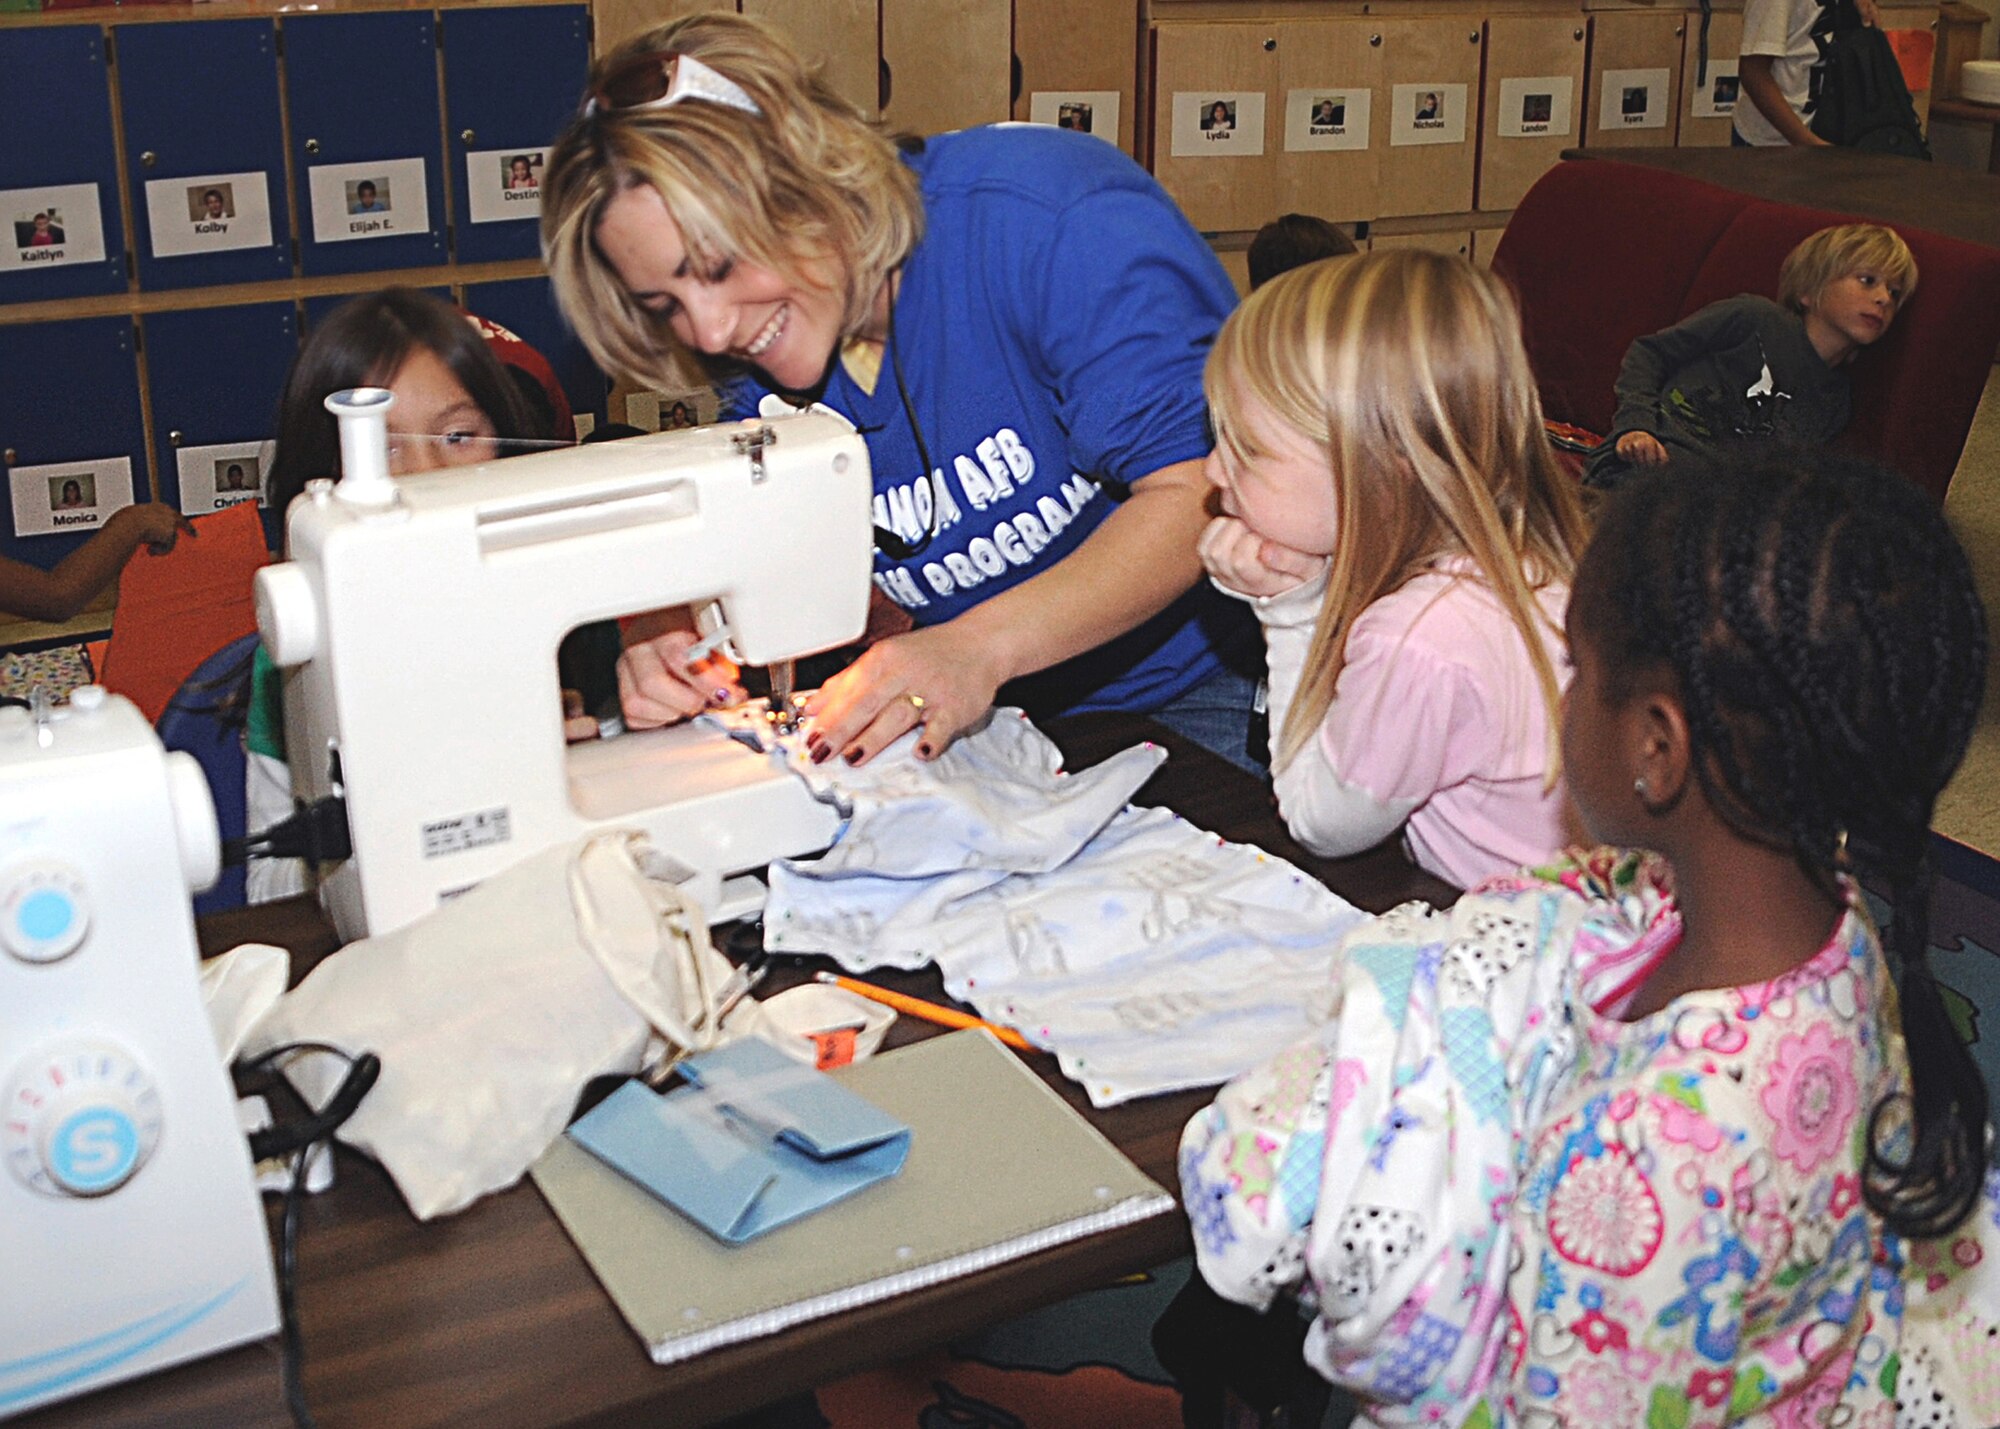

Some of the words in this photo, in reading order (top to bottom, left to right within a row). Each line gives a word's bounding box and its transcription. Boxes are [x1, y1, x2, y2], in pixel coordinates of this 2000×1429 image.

[1310, 125, 1345, 136] Brandon
[1413, 119, 1445, 130] Nicholas
[1521, 123, 1548, 133] Landon
[1206, 130, 1230, 141] Lydia
[504, 188, 542, 201] Destin
[194, 222, 228, 234] Kolby
[350, 221, 381, 234] Elijah
[384, 219, 394, 229] E.
[21, 248, 64, 262] Kaitlyn
[953, 427, 1036, 511] AFB
[53, 512, 98, 526] Monica
[922, 473, 1102, 596] PROGRAM
